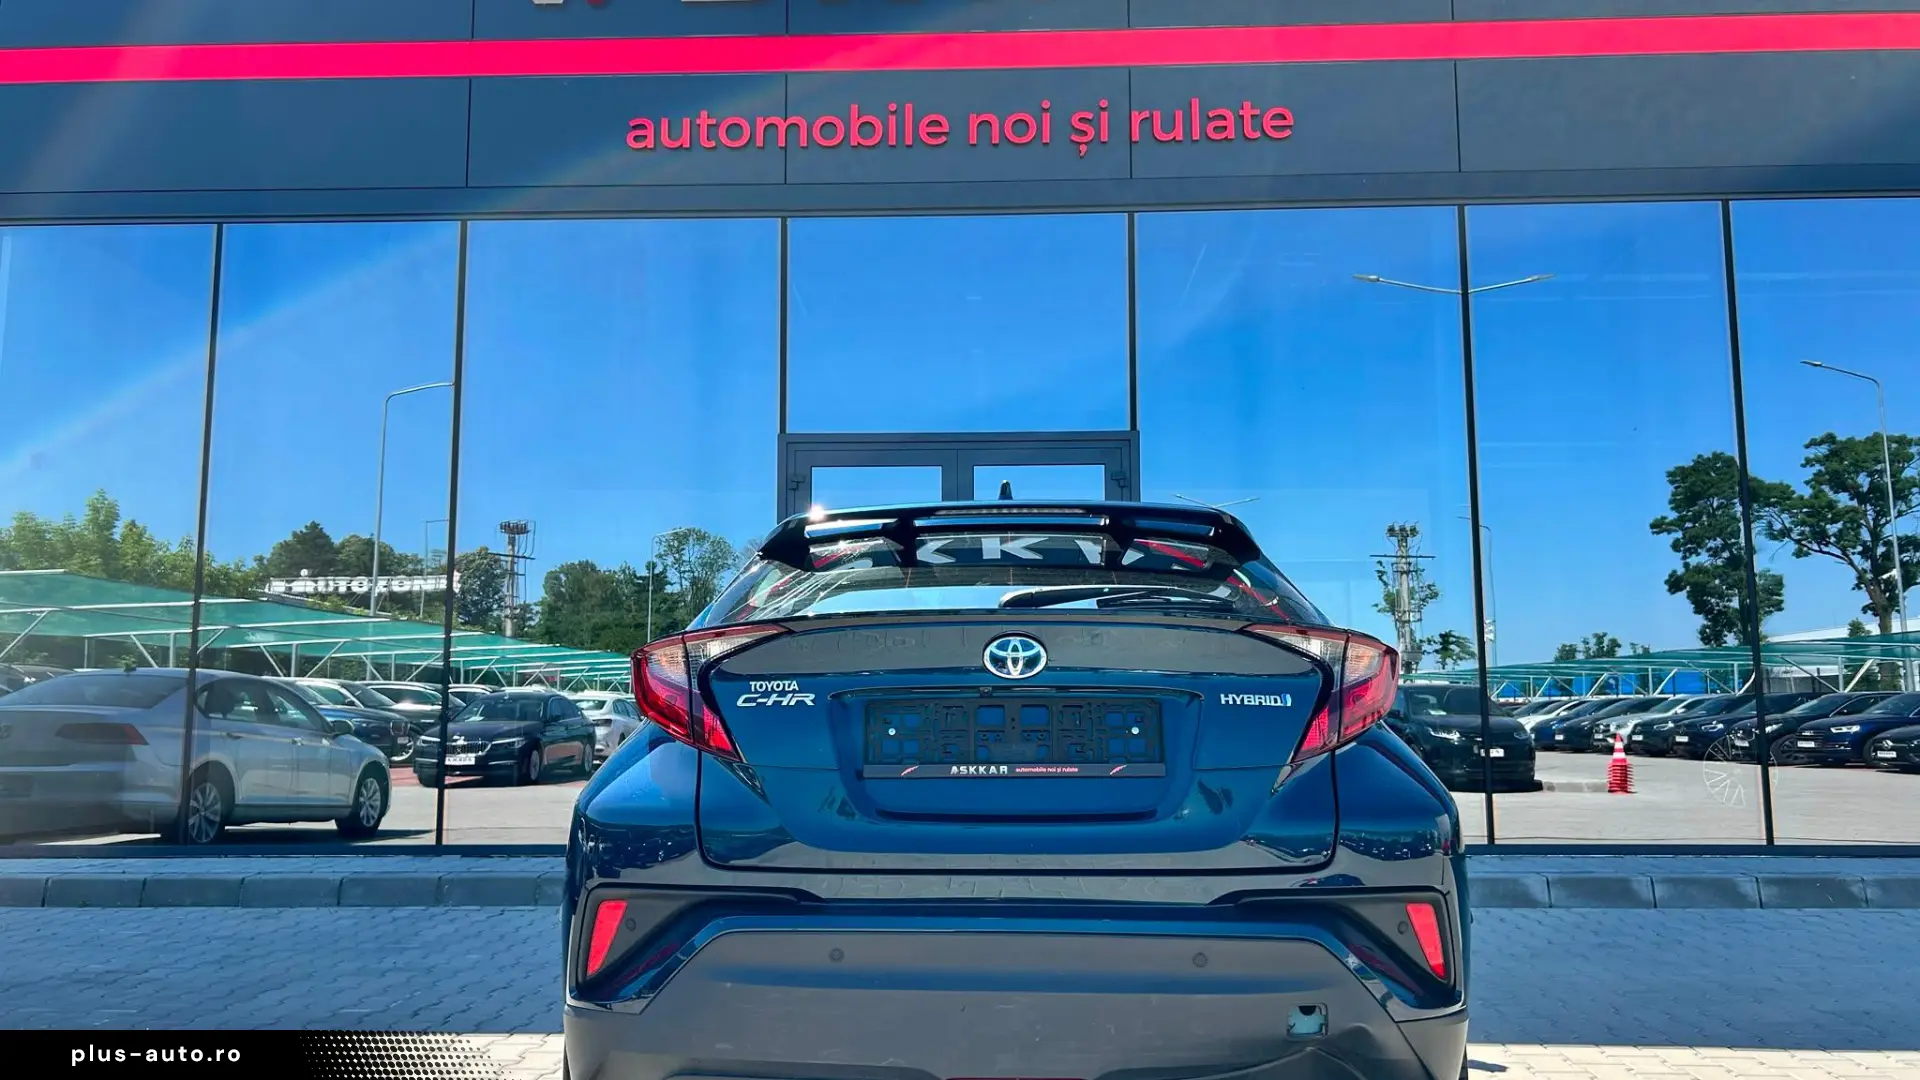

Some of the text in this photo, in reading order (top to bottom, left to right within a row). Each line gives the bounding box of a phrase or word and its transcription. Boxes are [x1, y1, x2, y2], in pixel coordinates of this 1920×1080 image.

[626, 98, 1294, 156] automobile noi și rulate
[749, 680, 799, 692] TOYOTA
[736, 693, 816, 707] C-HR
[1220, 693, 1282, 706] HYBRID
[950, 765, 1008, 775] ASKKAR
